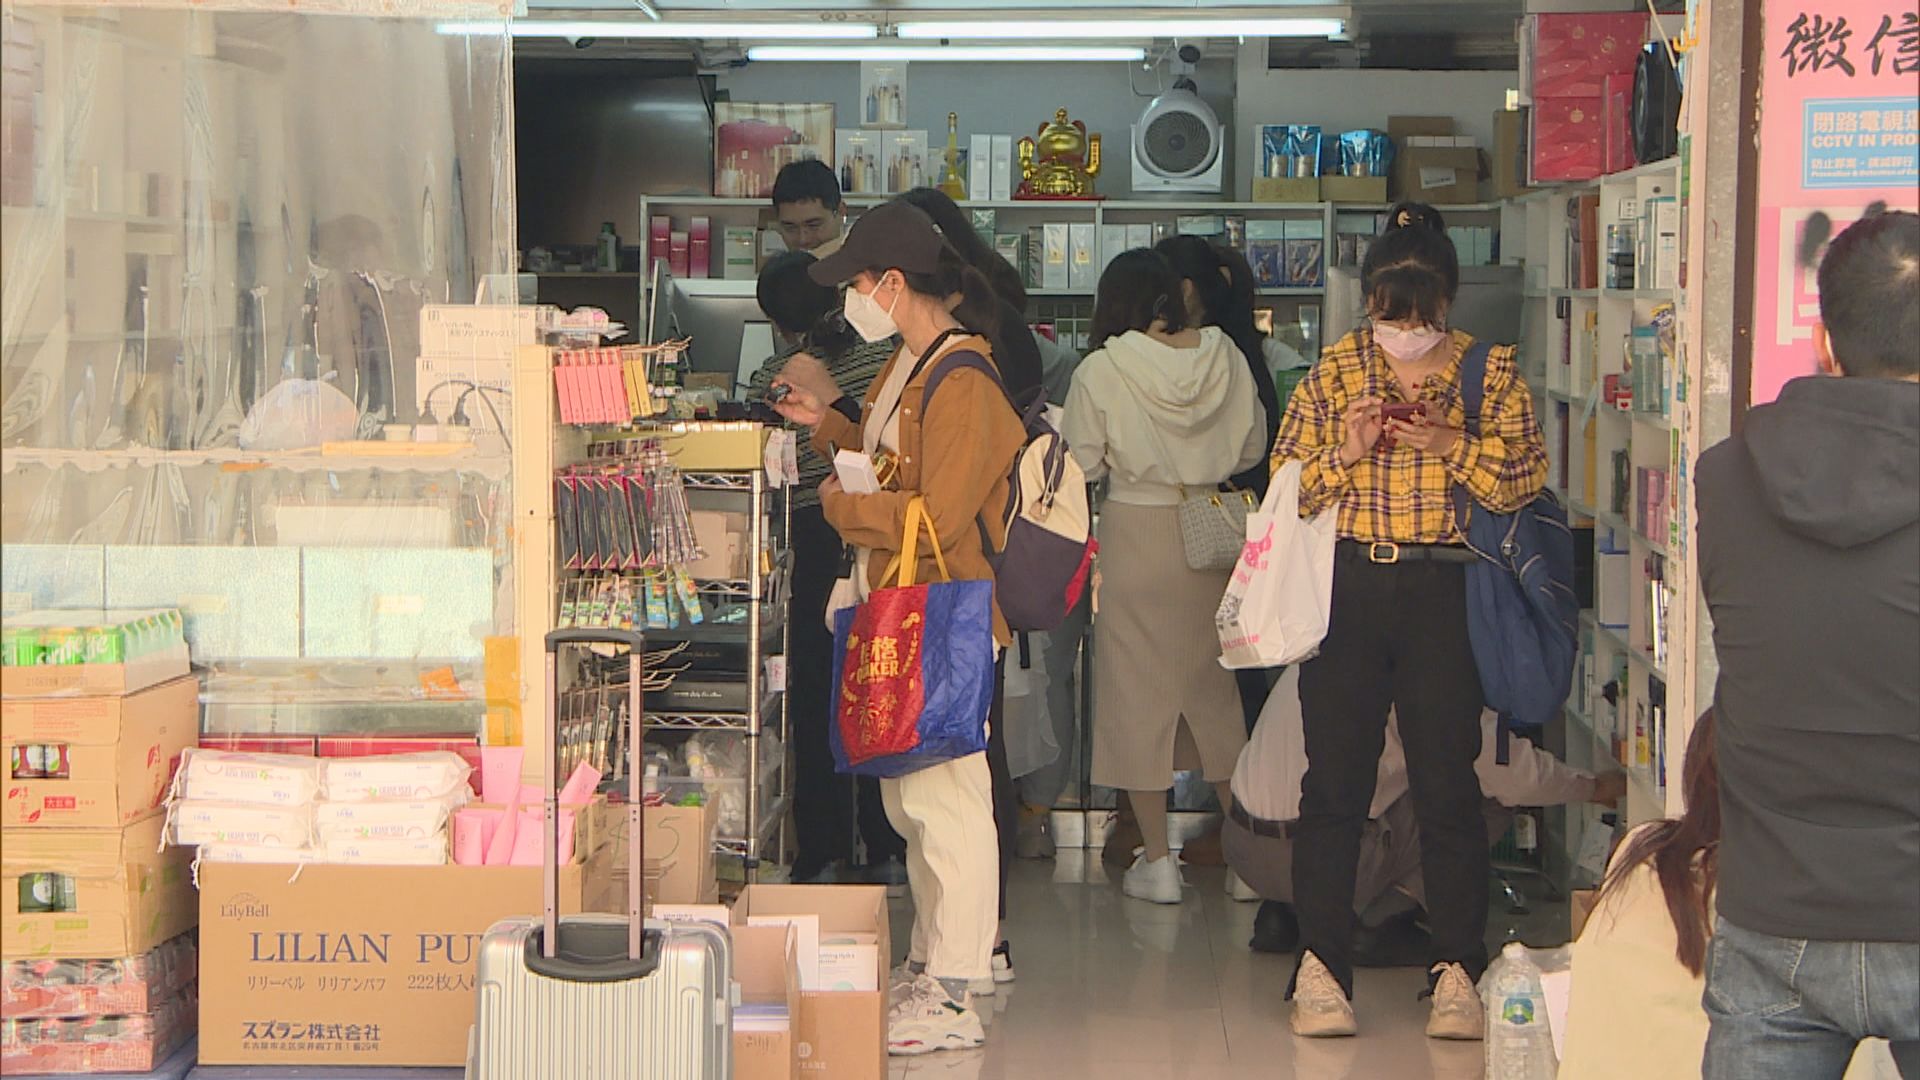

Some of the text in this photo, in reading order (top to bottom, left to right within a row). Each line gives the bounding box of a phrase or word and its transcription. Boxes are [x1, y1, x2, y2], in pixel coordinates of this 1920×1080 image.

[1780, 12, 1919, 78] 微信
[1812, 132, 1919, 148] CCTV IN PRO
[221, 904, 269, 920] LilyBell
[249, 932, 484, 964] LILIAN PU
[248, 975, 305, 991] リリーベル
[242, 1020, 381, 1041] スズラン株式会社
